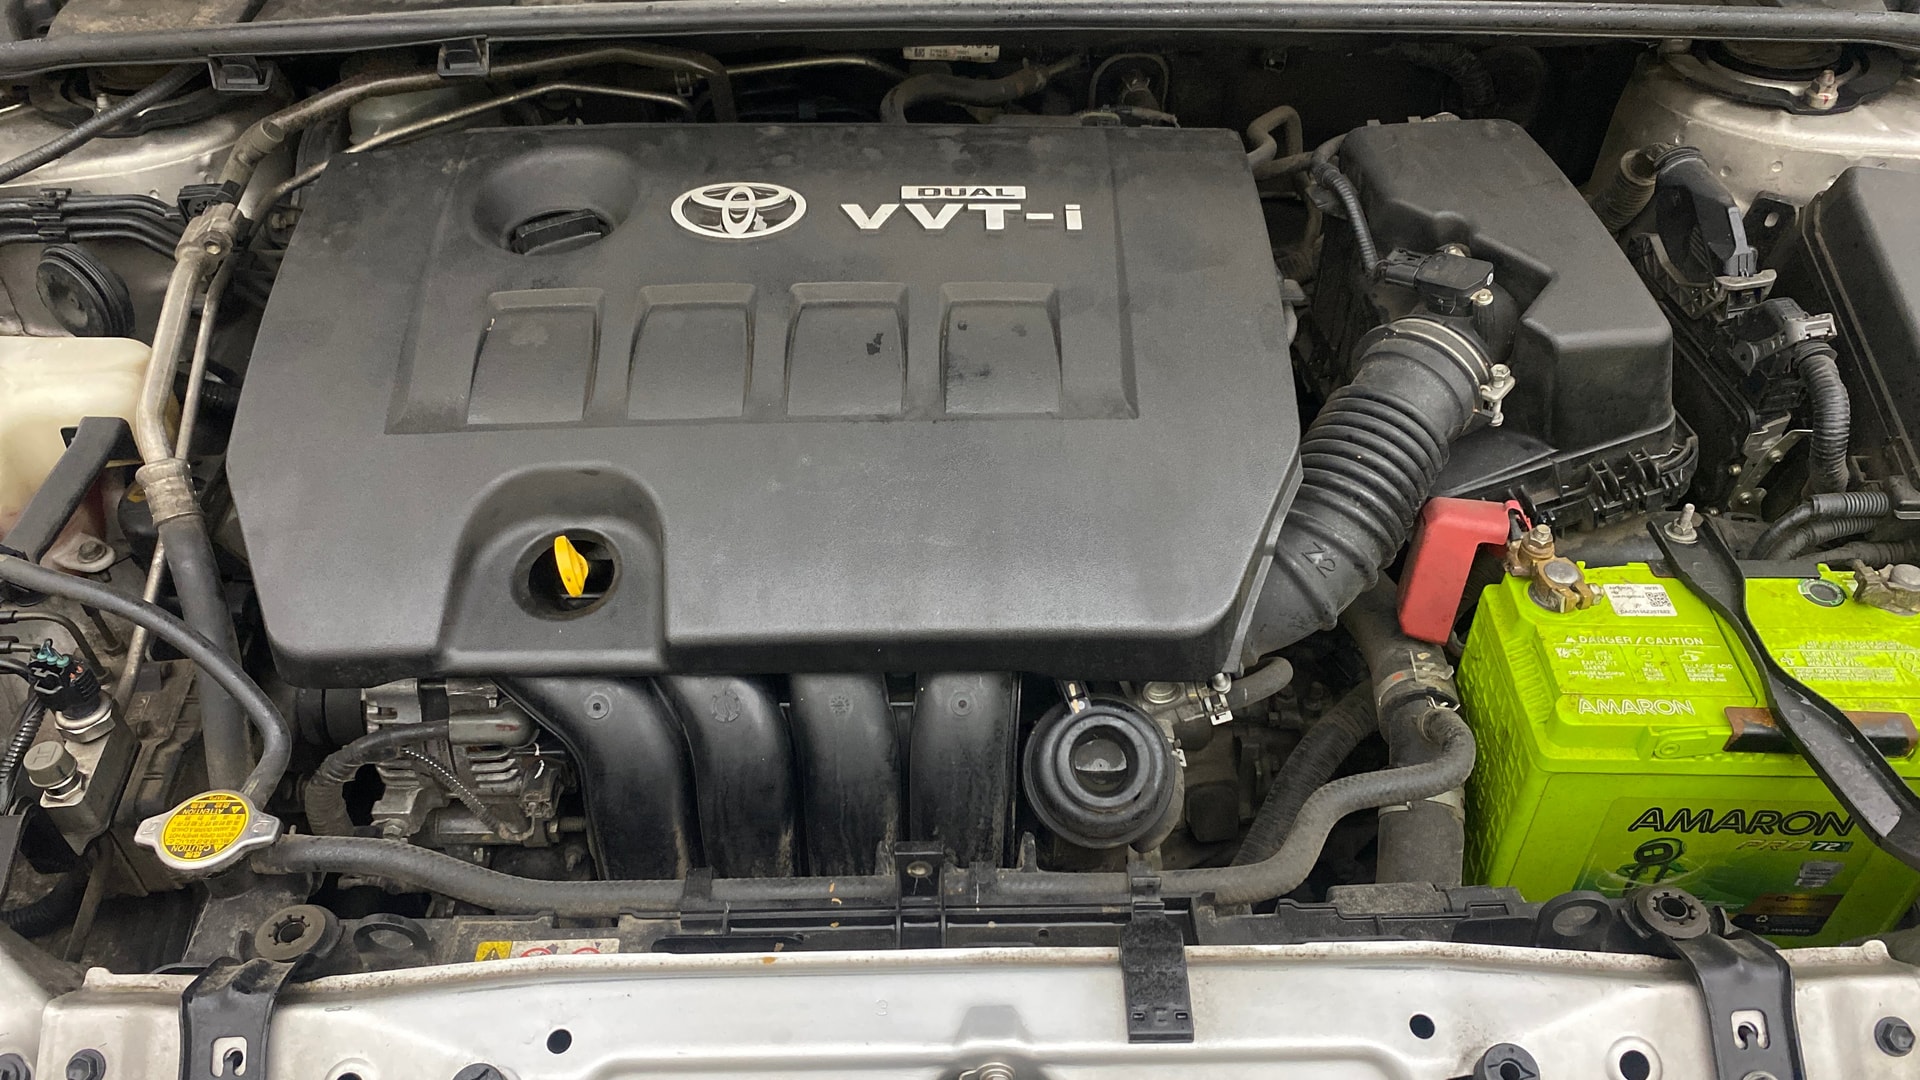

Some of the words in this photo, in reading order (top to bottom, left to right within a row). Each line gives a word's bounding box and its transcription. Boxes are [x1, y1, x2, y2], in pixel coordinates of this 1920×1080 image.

[917, 187, 1016, 198] DUAL
[840, 203, 1083, 231] VVT-i
[1578, 635, 1632, 645] DANGER
[1645, 636, 1704, 646] CAUTION
[1578, 697, 1697, 716] AMARON
[1627, 806, 1856, 837] AMARON
[1811, 841, 1842, 851] 72
